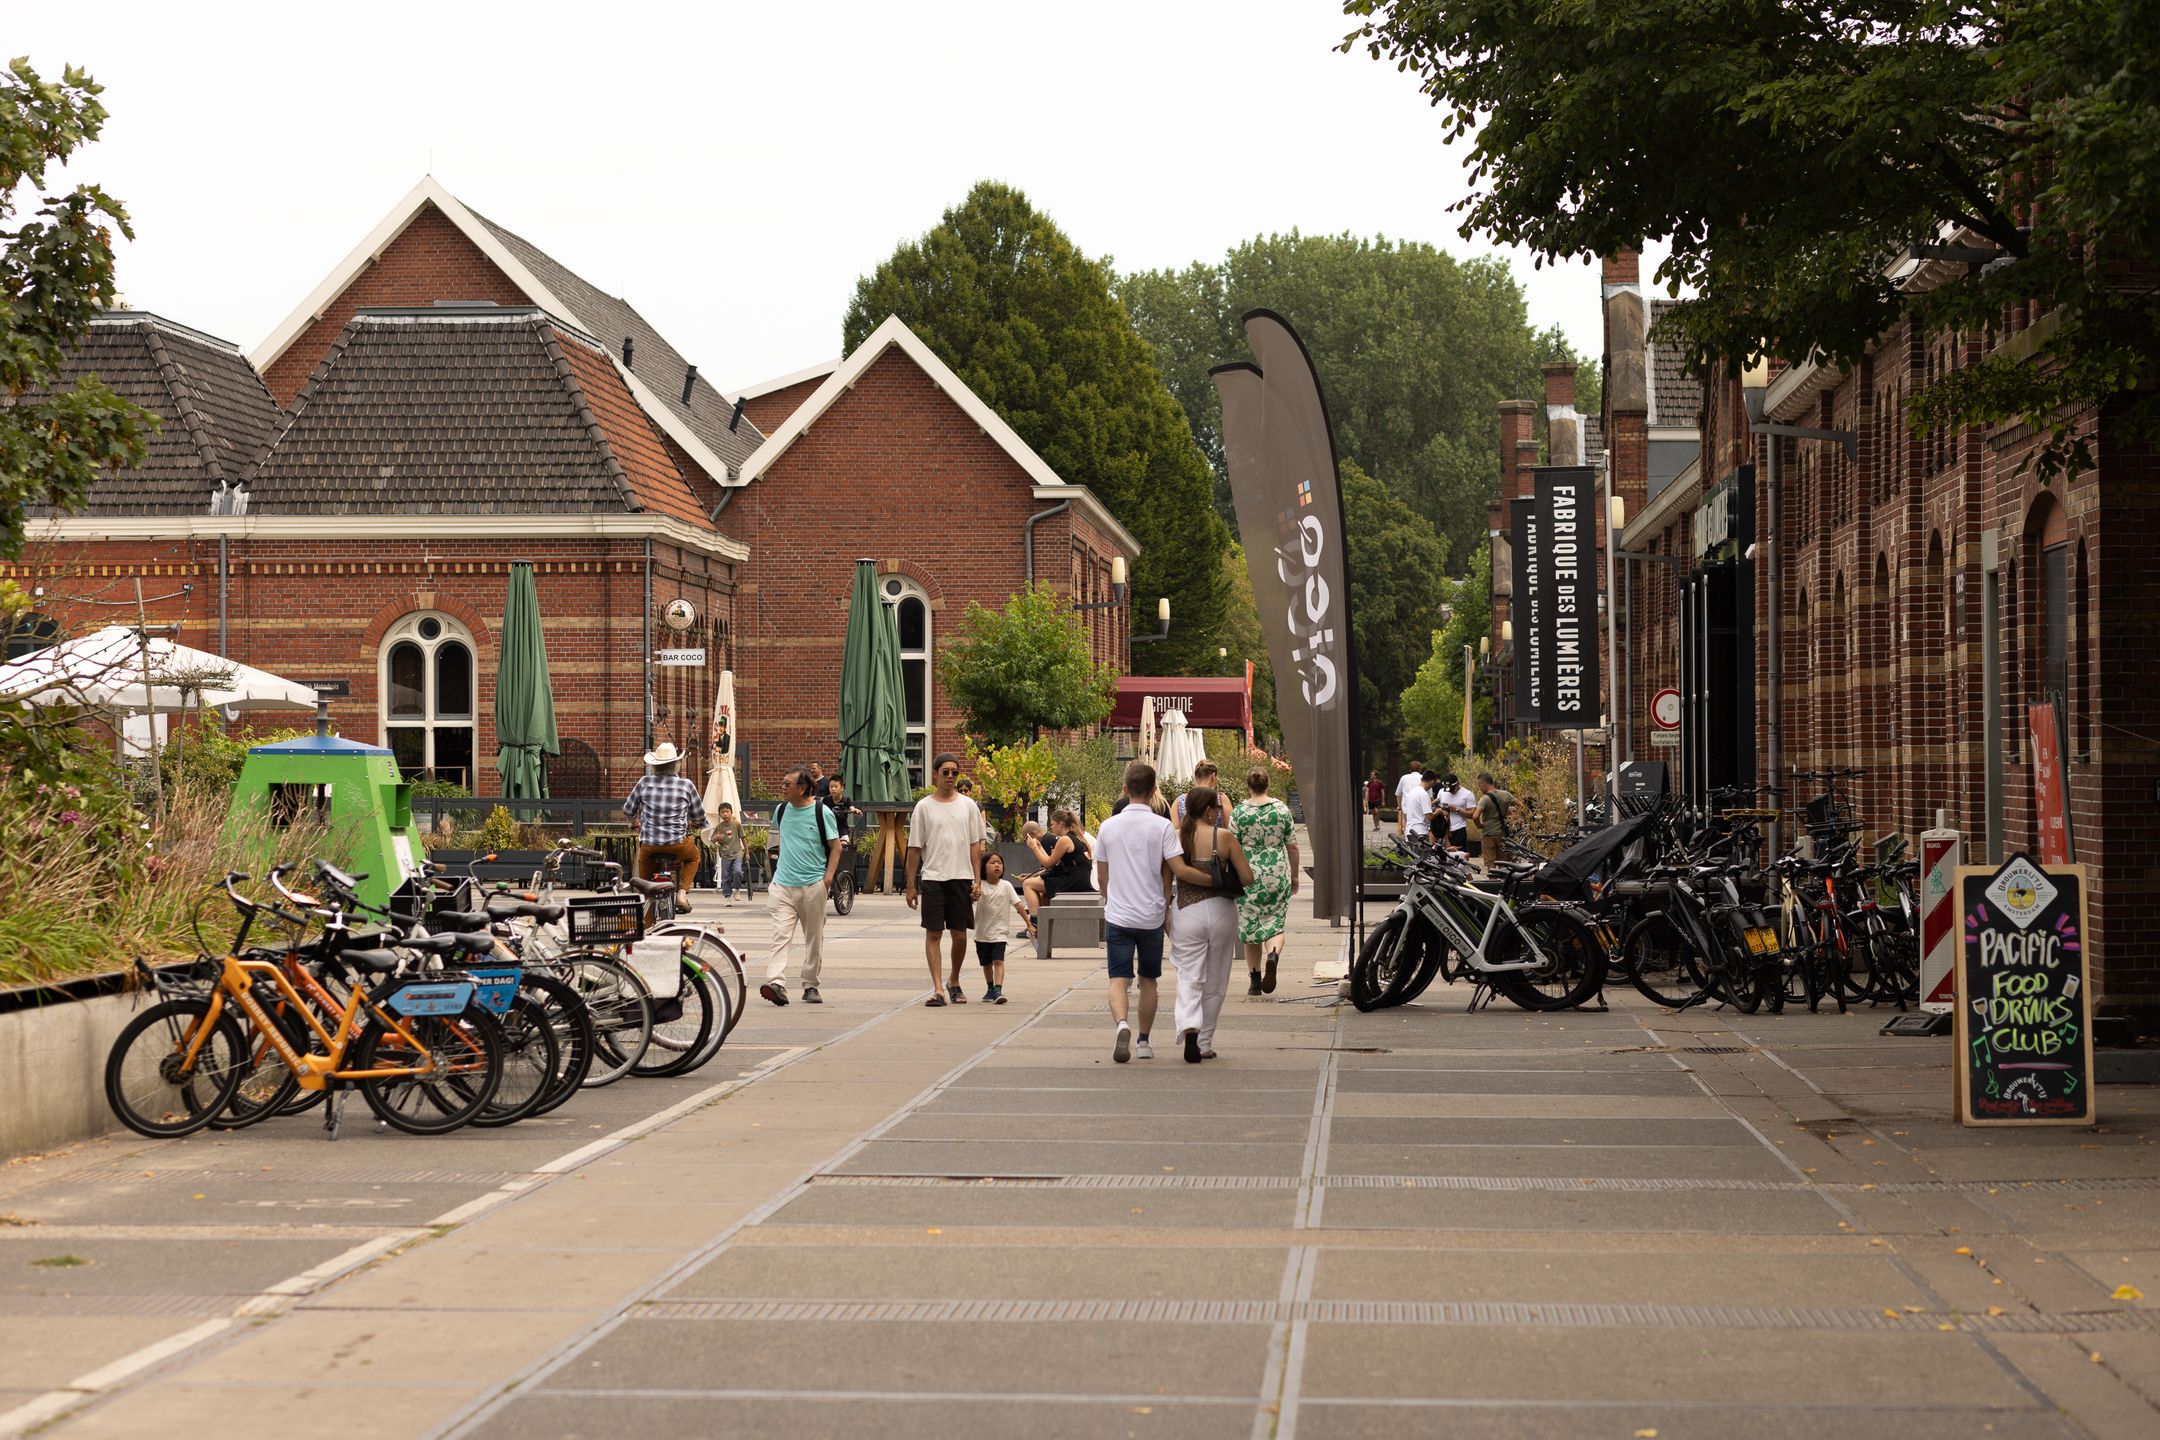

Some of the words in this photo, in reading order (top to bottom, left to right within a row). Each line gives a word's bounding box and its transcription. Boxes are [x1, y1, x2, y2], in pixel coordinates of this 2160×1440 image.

[1553, 485, 1578, 580] FABRIQUE
[1558, 585, 1576, 613] DES
[1556, 617, 1584, 712] LUMIÈRES
[1152, 696, 1193, 712] CANTINE
[2003, 903, 2041, 916] AMSTERDAM
[494, 977, 514, 985] DAG!
[1992, 970, 2049, 1000] FOOD
[241, 991, 271, 1026] DONKEY
[267, 1025, 301, 1067] REPUBLIC
[1992, 1029, 2062, 1056] CLUB
